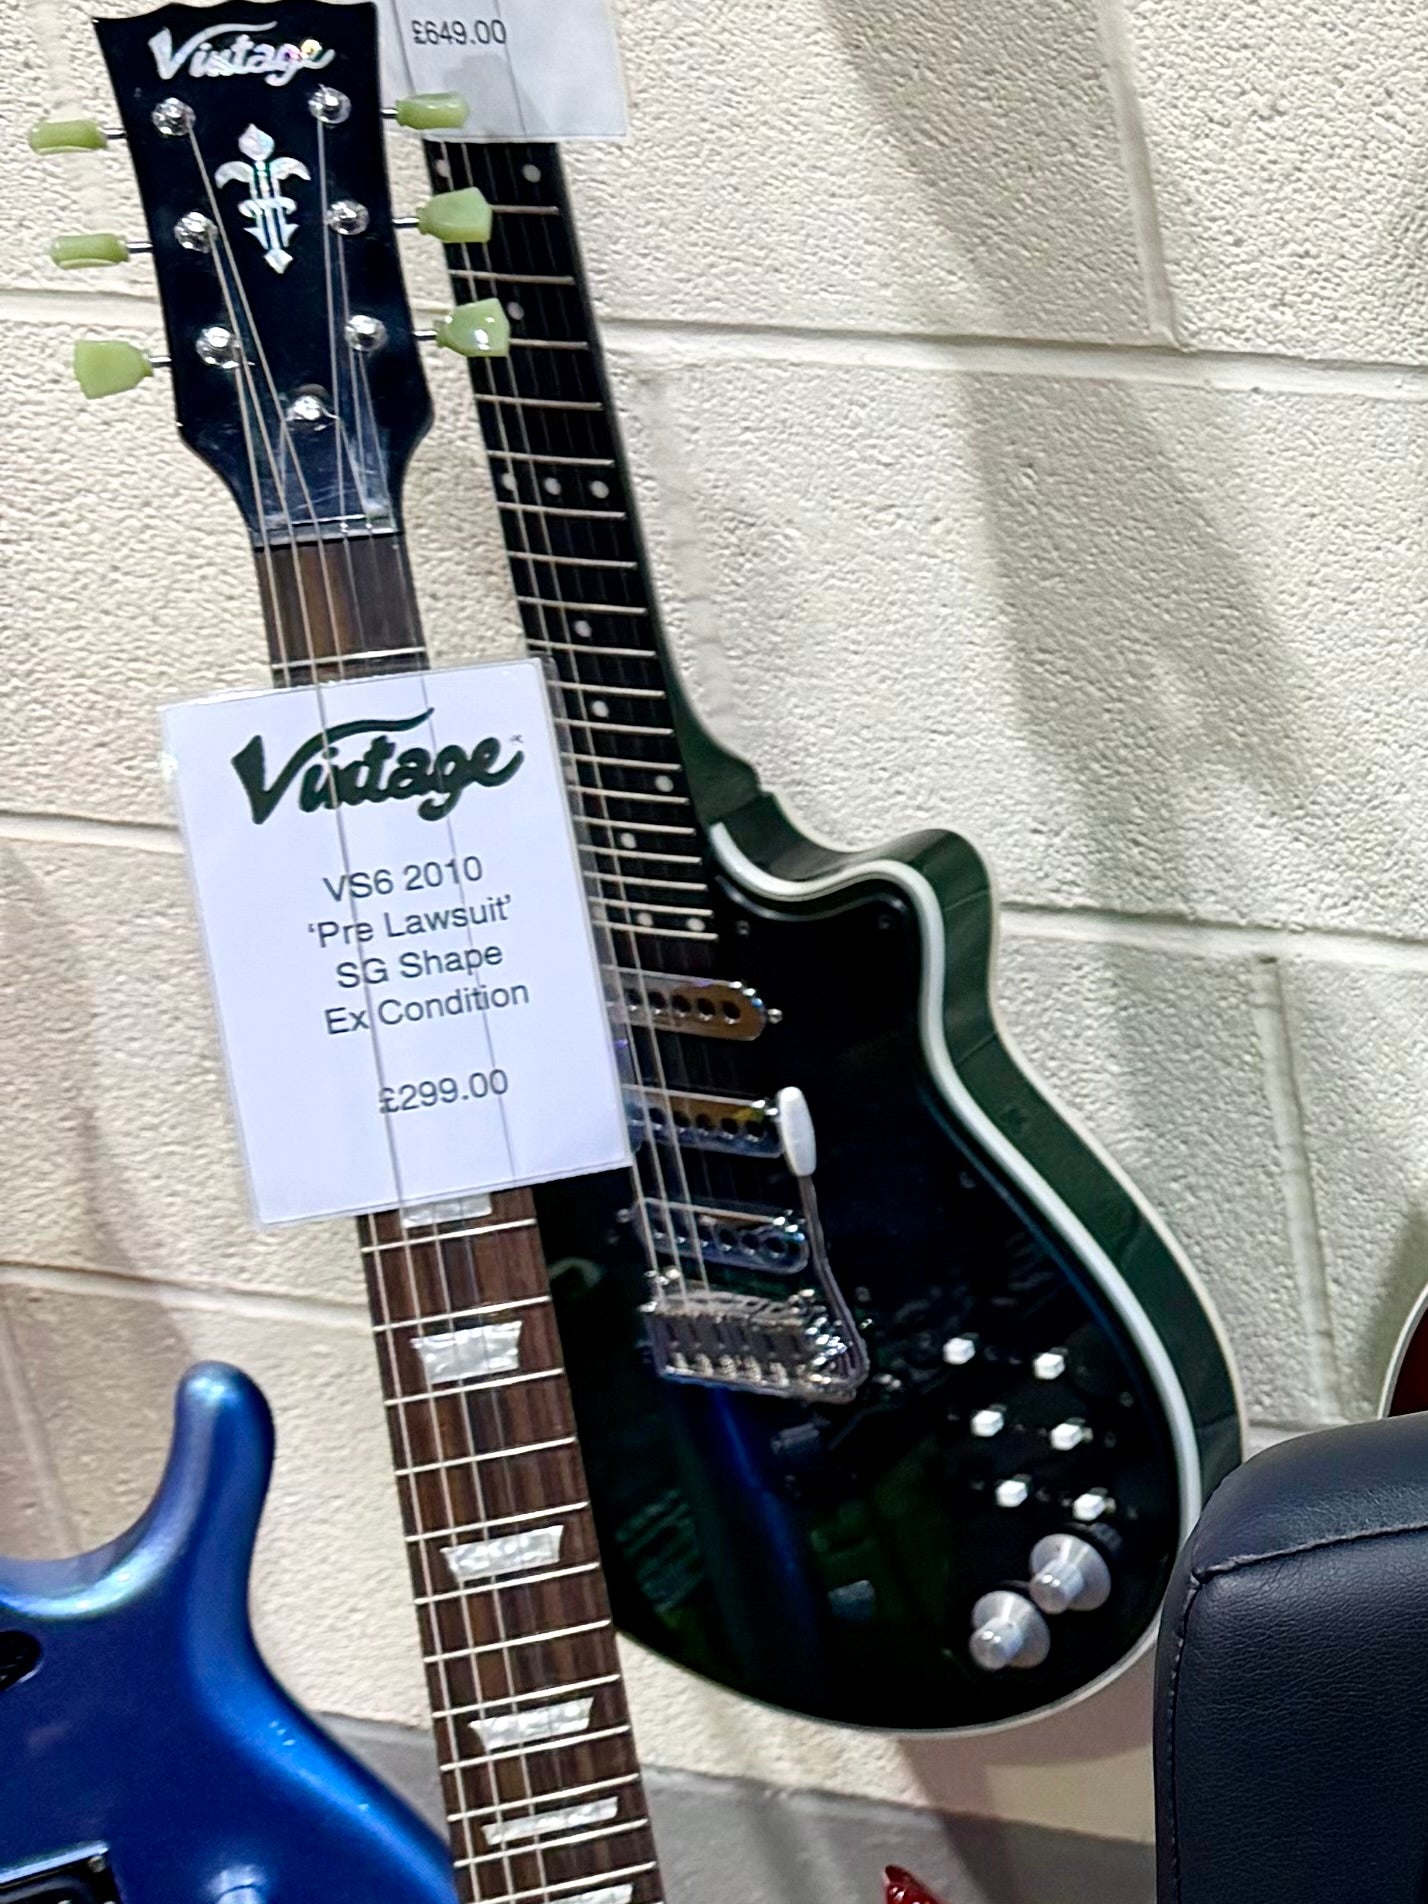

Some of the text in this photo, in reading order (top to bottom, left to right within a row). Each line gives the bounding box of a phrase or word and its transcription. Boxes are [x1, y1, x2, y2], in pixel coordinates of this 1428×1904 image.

[147, 20, 335, 88] Vintage
[411, 19, 507, 45] £649.00
[230, 707, 525, 825] Vintage
[322, 855, 483, 903] VS6 2010
[335, 944, 504, 989] SG Shape
[324, 983, 530, 1035] Ex Condition
[378, 1068, 509, 1115] £299.00
